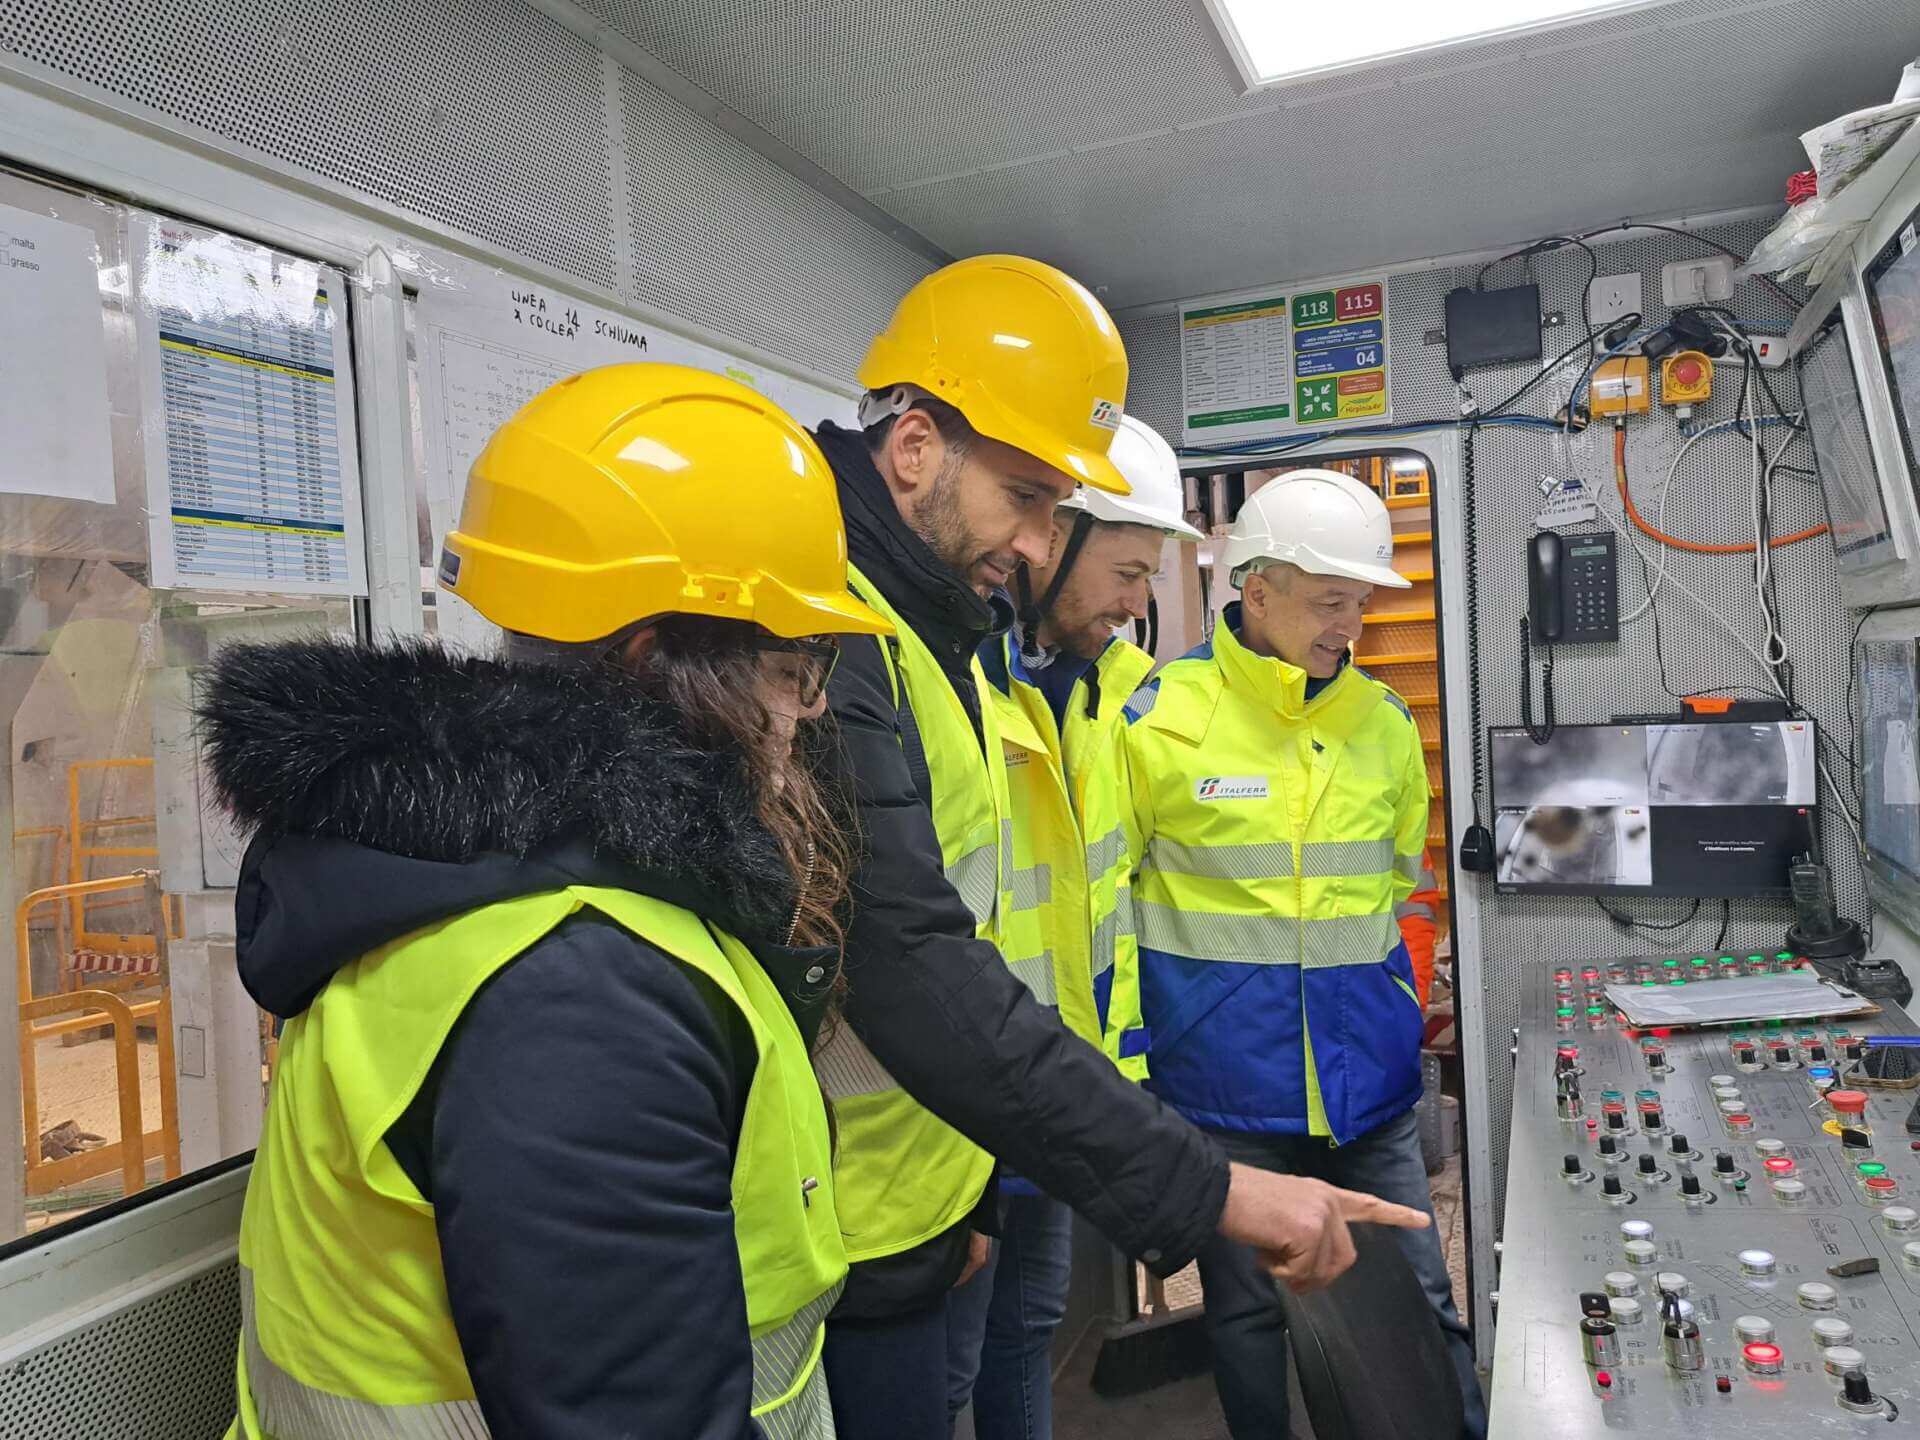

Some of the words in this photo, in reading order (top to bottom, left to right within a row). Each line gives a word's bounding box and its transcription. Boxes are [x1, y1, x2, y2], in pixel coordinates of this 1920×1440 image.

[11, 237, 36, 250] malta
[10, 257, 40, 272] grasso
[1300, 300, 1329, 318] 118
[1344, 293, 1374, 311] 115
[511, 290, 546, 313] LINEA
[565, 307, 580, 332] 14
[594, 319, 648, 352] SCHIUMA
[529, 314, 575, 341] COCLEA
[1356, 351, 1377, 366] 04
